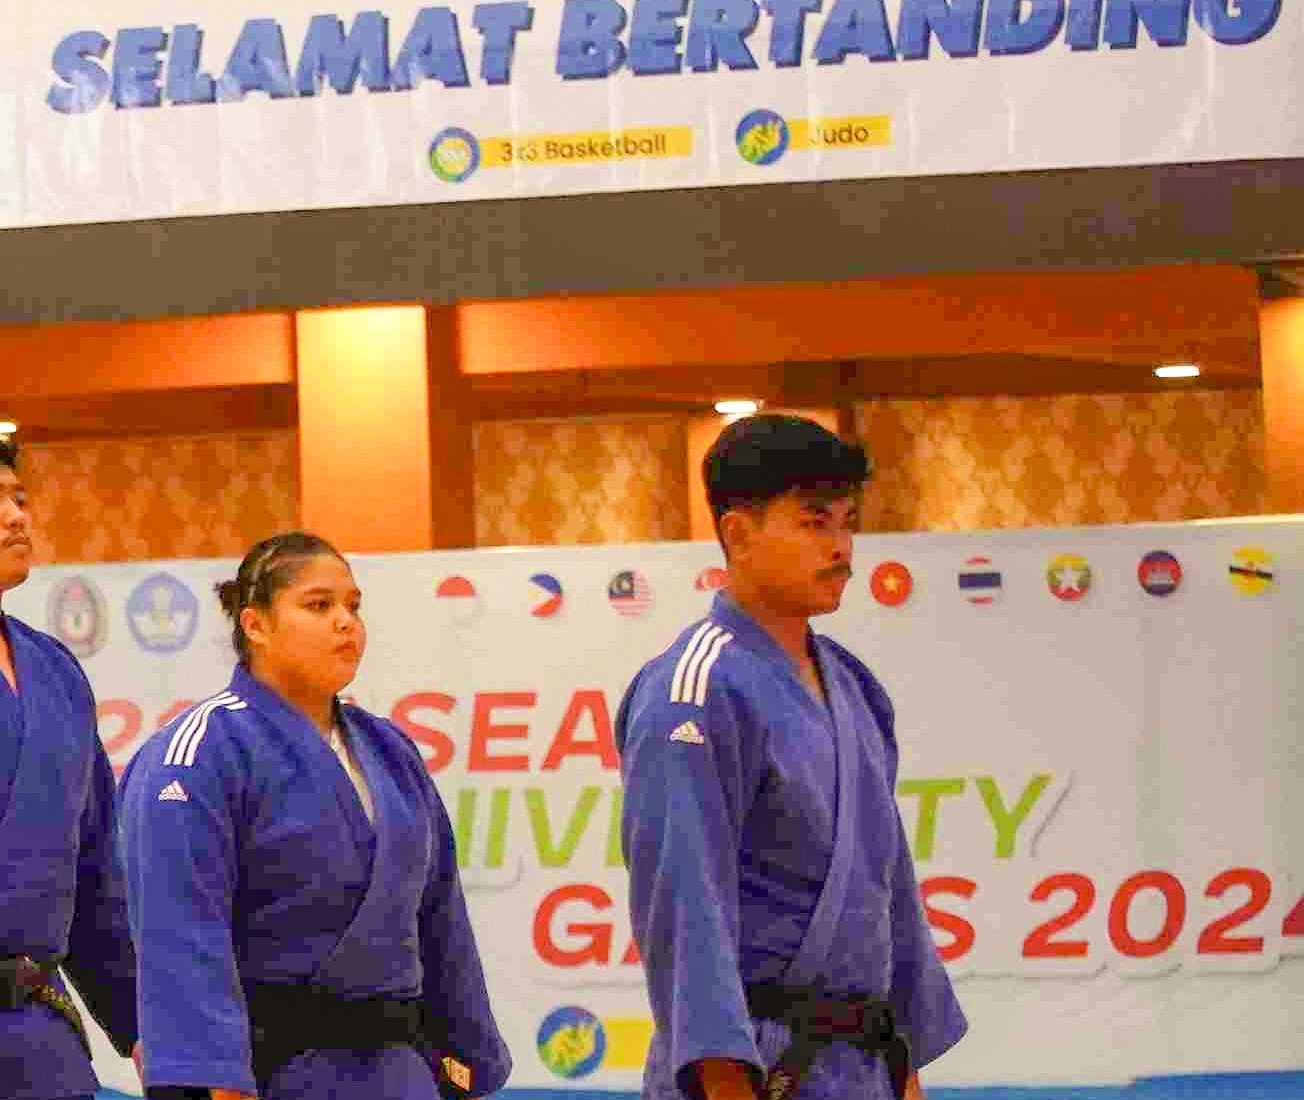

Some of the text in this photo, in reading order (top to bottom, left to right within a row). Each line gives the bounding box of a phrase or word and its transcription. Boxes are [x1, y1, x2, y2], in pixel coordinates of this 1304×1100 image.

[45, 0, 1285, 114] SELAMAT BERTANDING
[544, 134, 667, 159] Basketball
[389, 689, 621, 774] SEA
[1021, 866, 1304, 959] 202
